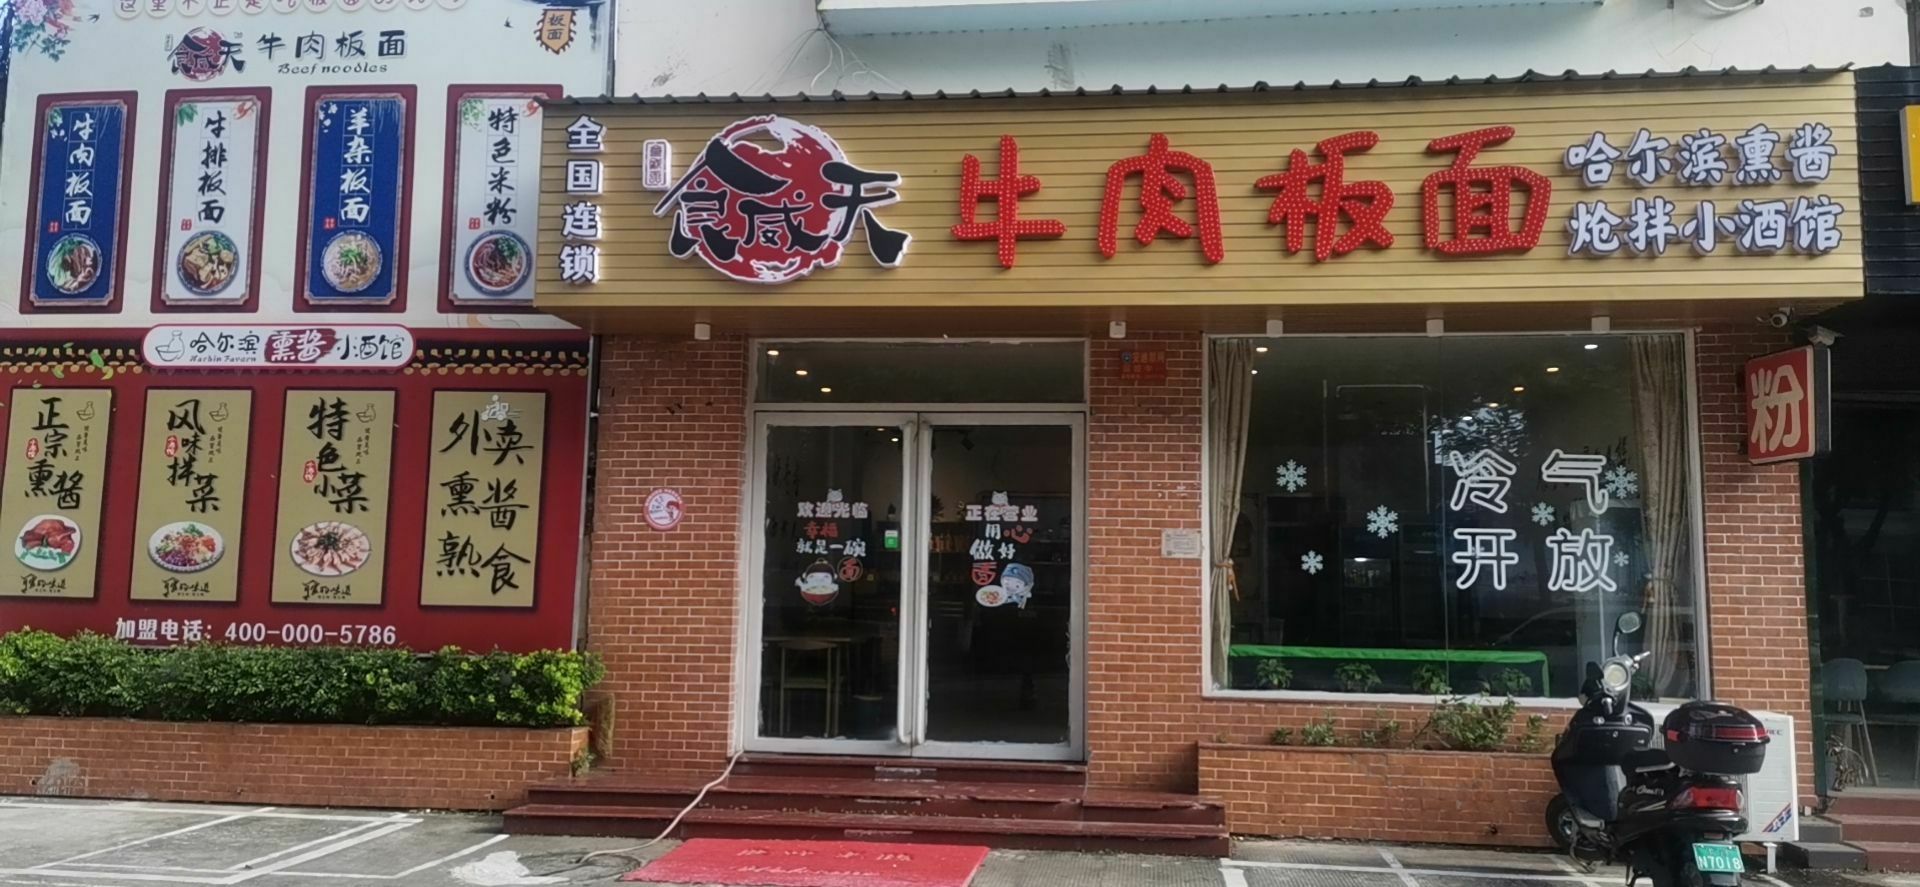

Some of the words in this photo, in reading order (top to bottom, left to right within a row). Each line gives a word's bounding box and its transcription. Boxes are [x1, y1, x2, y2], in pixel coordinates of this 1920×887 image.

[256, 30, 406, 60] 牛肉板面
[547, 13, 567, 40] 板面
[278, 63, 317, 75] Beef
[321, 62, 388, 74] noodles
[65, 112, 95, 225] 牛肉板面
[198, 110, 228, 224] 牛排板面
[340, 106, 372, 223] 羊杂板面
[484, 105, 519, 226] 特色米粉
[1565, 122, 1838, 187] 哈尔滨熏酱
[559, 113, 606, 286] 全国连锁
[951, 125, 1552, 268] 牛肉板面
[1568, 195, 1844, 256] 炝拌小酒馆
[440, 410, 535, 466] 外卖
[1751, 364, 1804, 453] 粉
[24, 397, 84, 510] 正宗熏酱
[166, 399, 219, 513] 风味拌菜
[306, 397, 369, 514] 特色小菜
[1450, 449, 1609, 514] 冷气
[440, 471, 530, 530] 熏酱
[797, 502, 868, 518] 欢迎光临
[965, 505, 1038, 521] 正在营业
[436, 531, 531, 595] 熟食
[796, 538, 866, 556] 就是一碗
[970, 539, 1016, 560] 做好
[985, 524, 1032, 543] 用心
[1452, 527, 1617, 591] 开放
[225, 622, 396, 645] 400-000-5786
[1698, 856, 1741, 869] N7018
